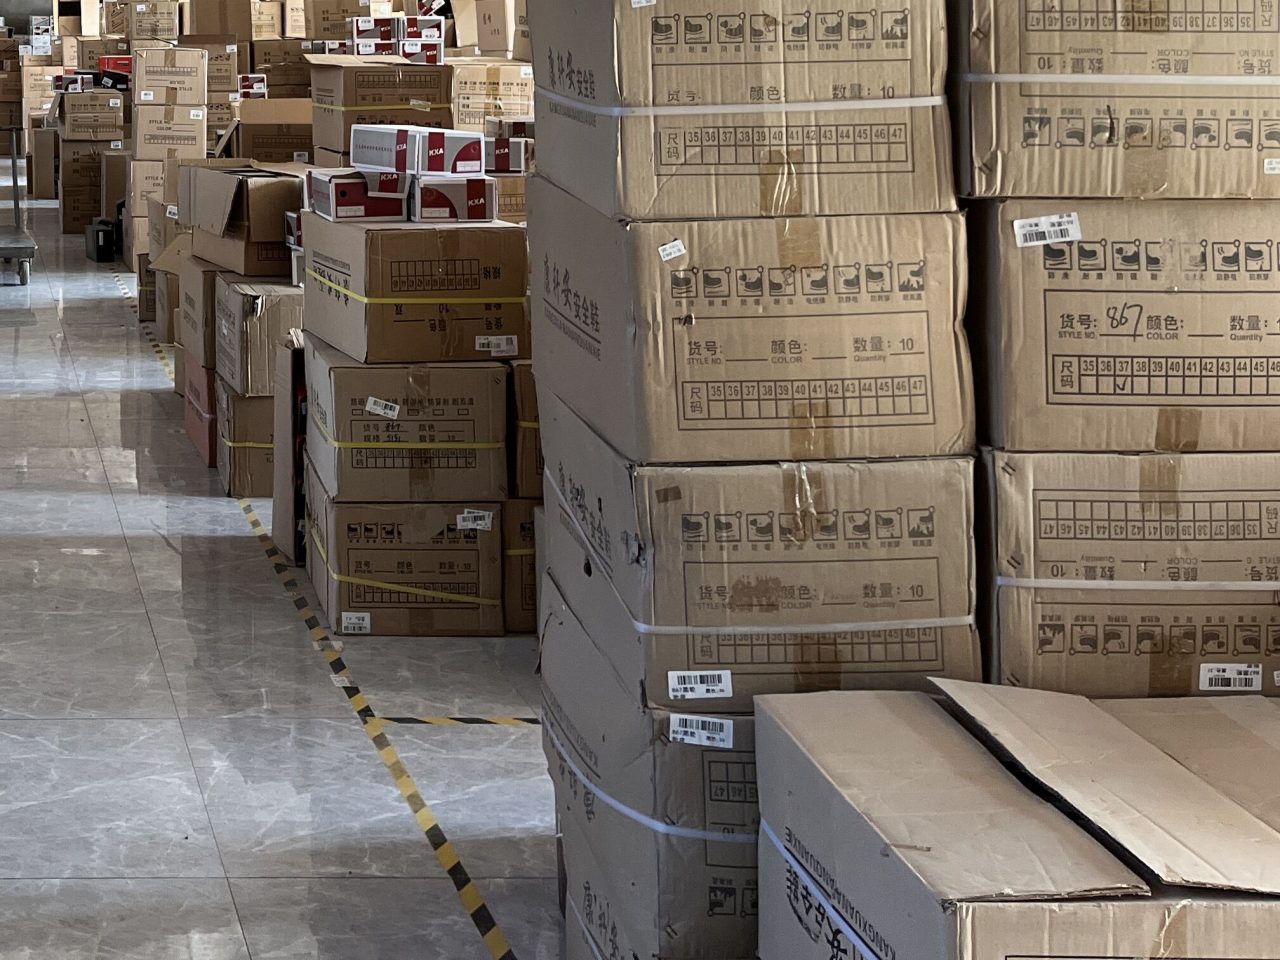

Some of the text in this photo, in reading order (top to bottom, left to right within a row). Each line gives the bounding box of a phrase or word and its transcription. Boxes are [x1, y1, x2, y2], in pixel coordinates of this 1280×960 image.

[1030, 15, 1217, 27] 37 38 39 40 41 42 43 44 45 46 47
[1038, 57, 1053, 69] 10
[880, 86, 895, 99] 10
[688, 128, 902, 143] 35 36 37 38 39 40 41 42 43 44 45 46 47
[428, 147, 444, 157] KXA
[667, 133, 680, 160] 尺码
[380, 172, 398, 182] KXA
[468, 197, 485, 207] KXA
[1060, 314, 1268, 331] 货号: 颜色: 数量:
[1106, 302, 1144, 342] 867
[1230, 333, 1263, 342] Quantity
[688, 341, 723, 356] 货号:
[770, 339, 808, 354] 颜色:
[898, 338, 914, 350] 10
[771, 356, 802, 364] COLOR
[854, 354, 886, 363] Quantity
[1083, 361, 1264, 373] 35 36 37 38 39 40 41 42 43 44 45
[1060, 361, 1074, 388] 尺码
[711, 380, 922, 396] 35 36 37 38 39 40 41 42 43 44 45 46 47
[690, 388, 703, 414] 尺码
[1051, 564, 1066, 577] 10
[909, 584, 924, 598] 10
